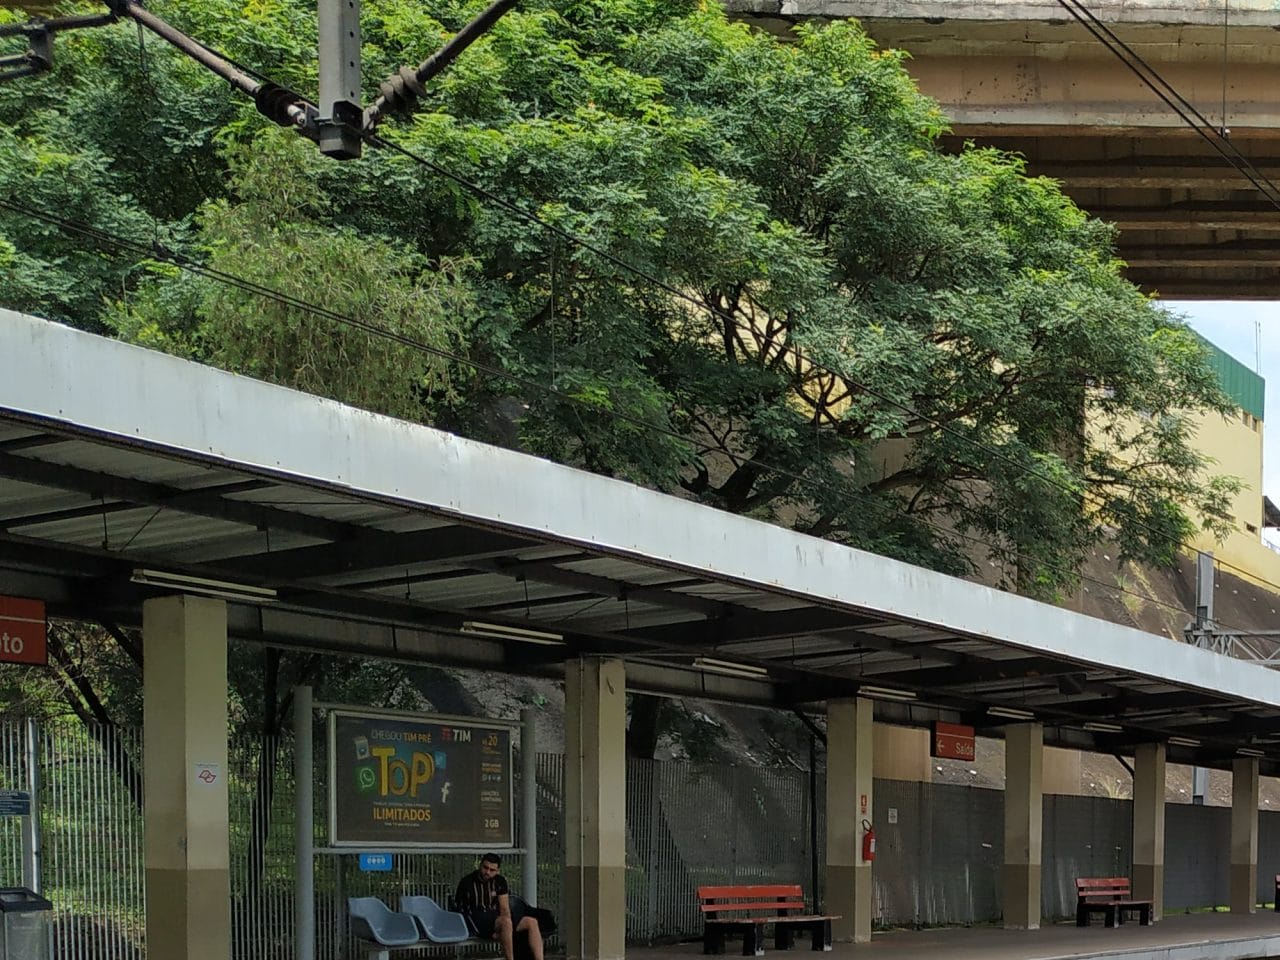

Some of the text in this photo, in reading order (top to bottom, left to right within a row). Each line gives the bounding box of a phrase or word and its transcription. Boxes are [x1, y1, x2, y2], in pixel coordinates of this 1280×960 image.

[0, 632, 24, 655] to
[371, 728, 403, 742] CHEGOU
[403, 731, 418, 743] TIM
[453, 728, 472, 742] TIM
[373, 806, 432, 822] ILIMITADOS
